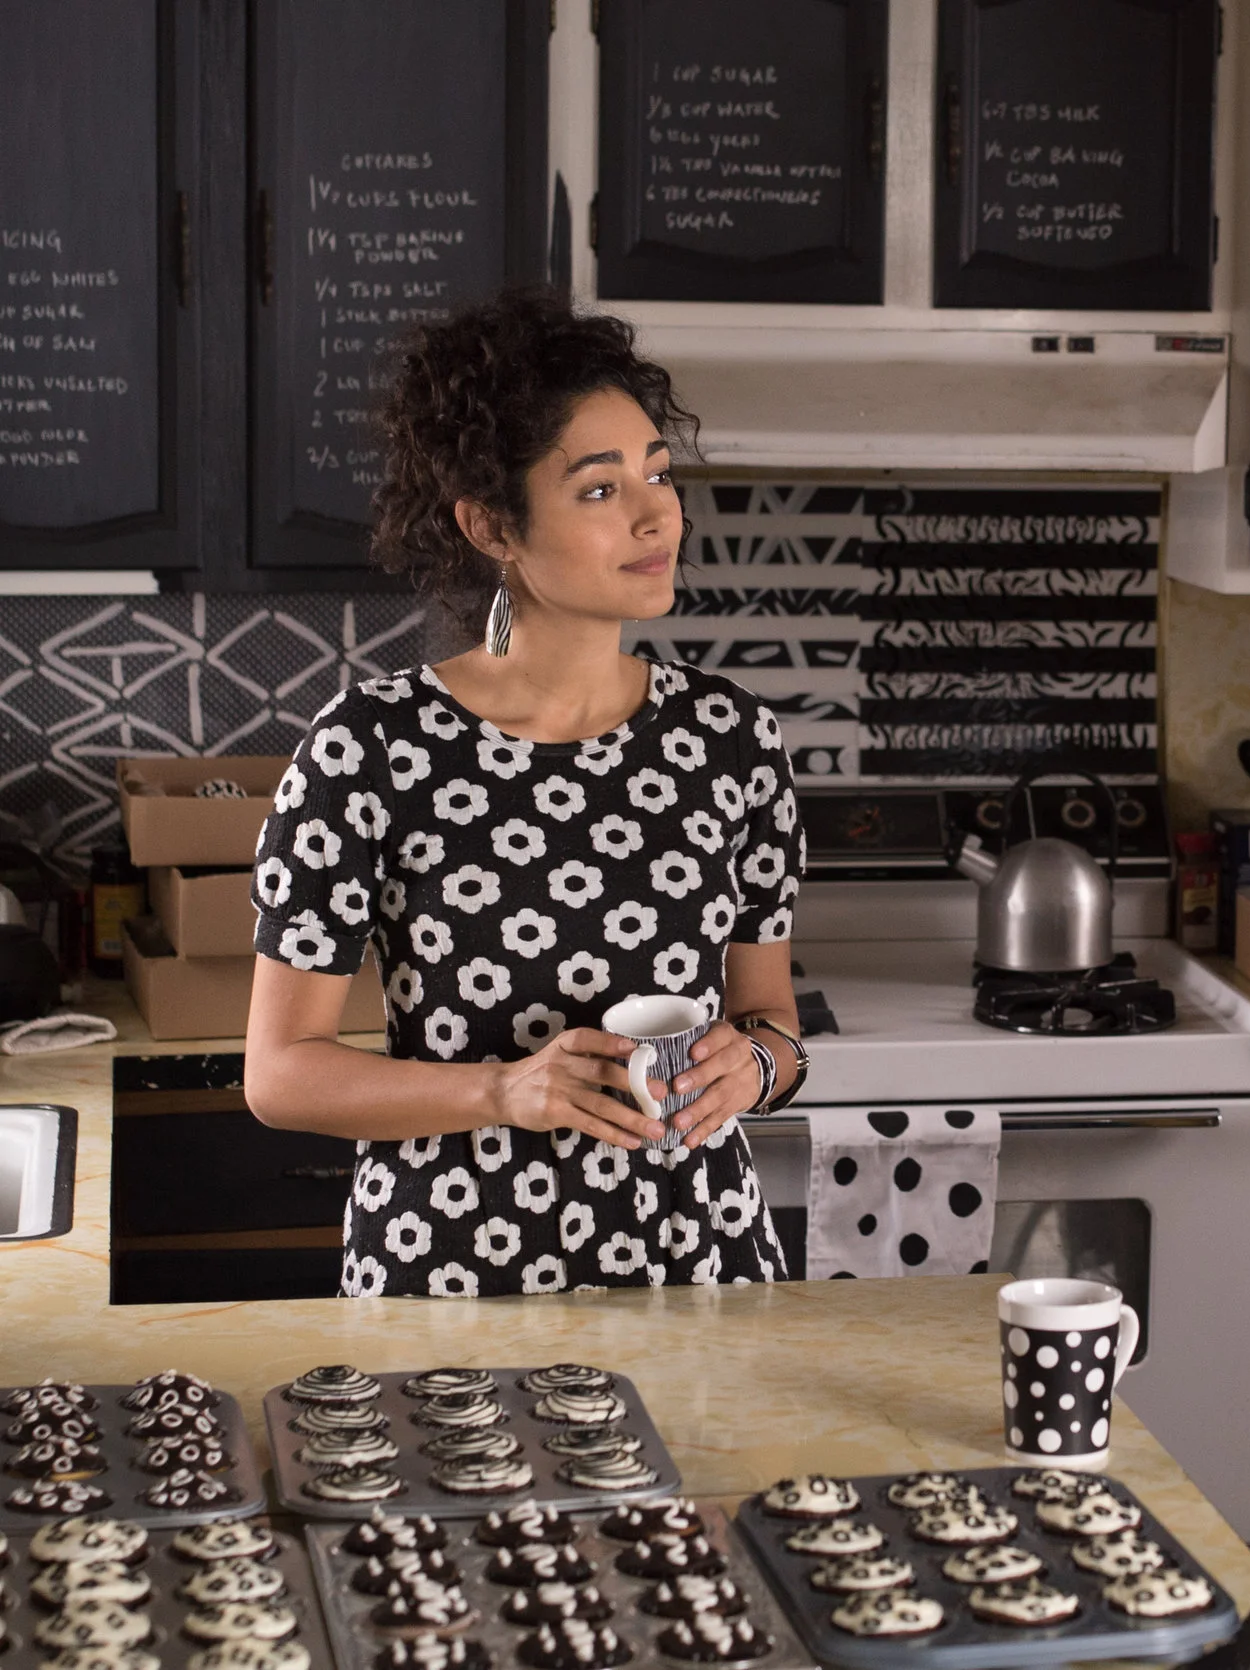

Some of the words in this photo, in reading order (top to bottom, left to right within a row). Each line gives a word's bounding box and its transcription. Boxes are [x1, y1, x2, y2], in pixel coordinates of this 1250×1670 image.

[710, 65, 778, 87] SUGAR
[680, 101, 712, 118] CUP
[717, 101, 781, 120] WATER
[341, 152, 434, 172] CUPCAKES
[1005, 170, 1060, 190] COCOA
[346, 189, 401, 209] CUPS
[407, 190, 480, 210] FLOUR
[664, 211, 735, 232] SUGAR
[354, 246, 440, 265] POWDER
[52, 269, 119, 288] WHITES
[402, 280, 449, 298] SALT
[22, 303, 86, 322] SUGAR
[44, 375, 129, 395] UNSALTED
